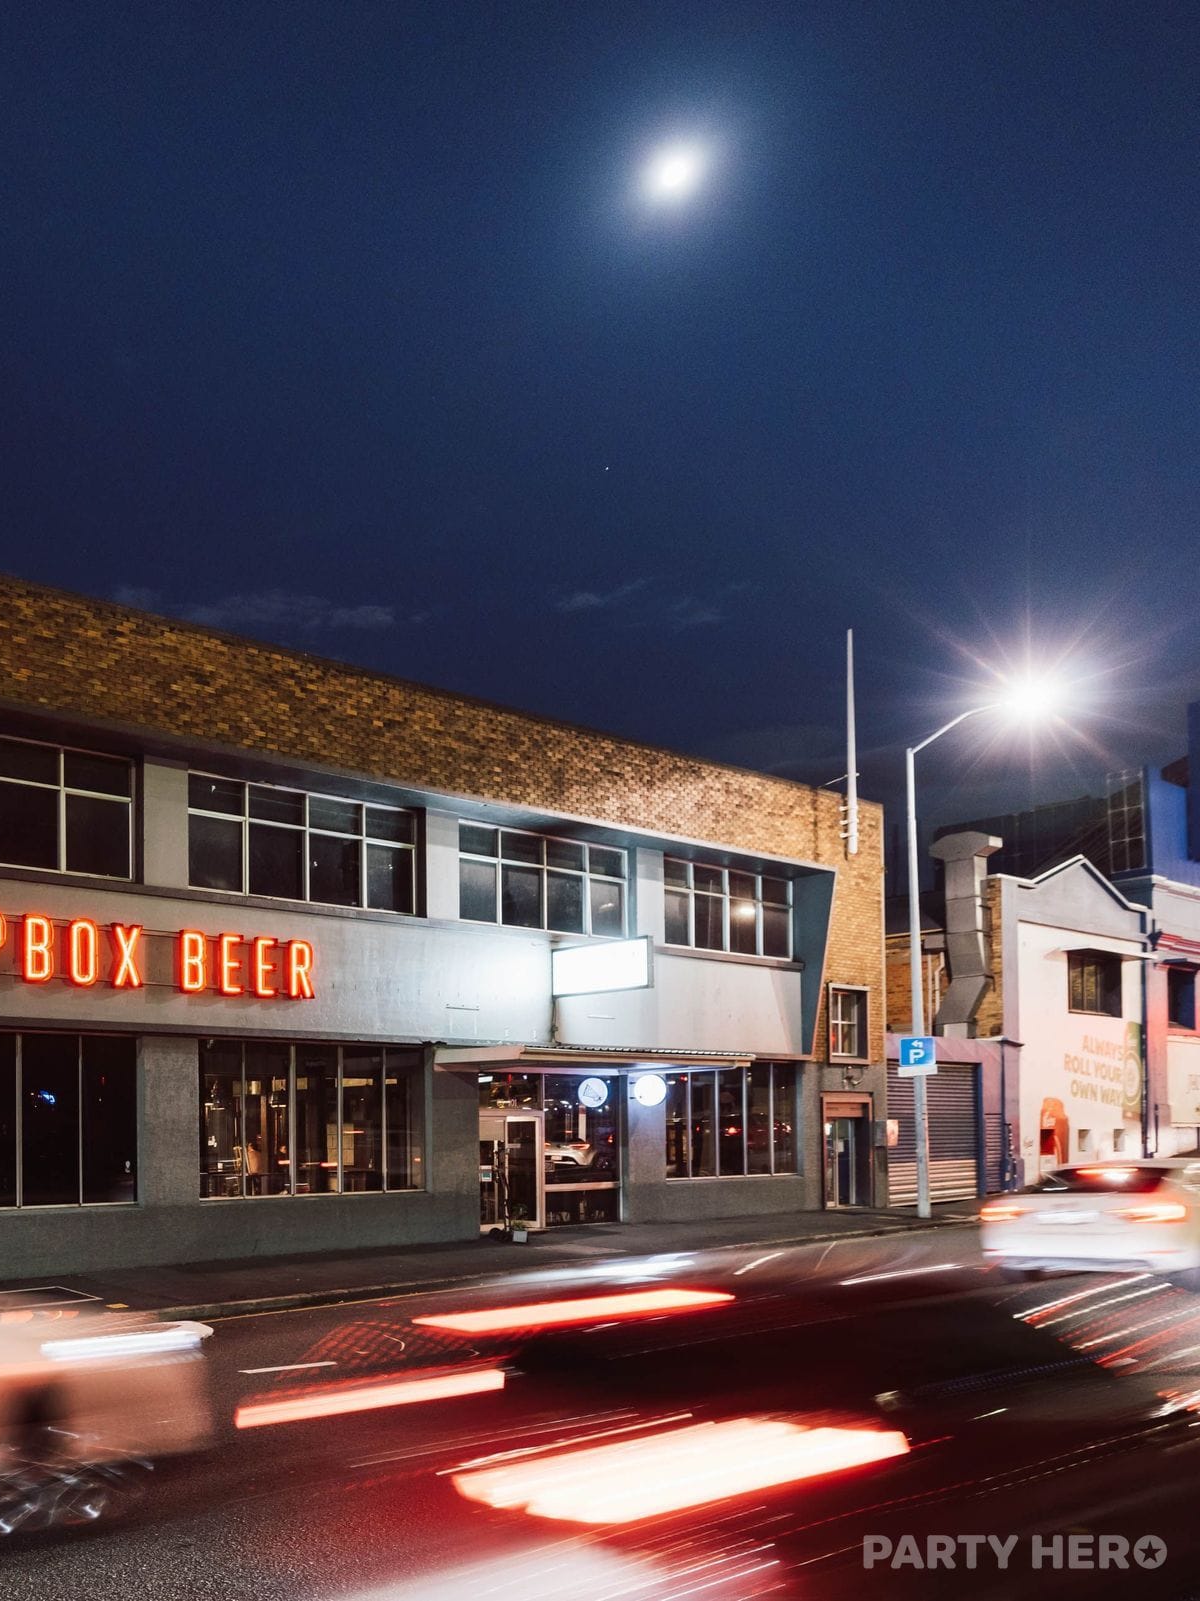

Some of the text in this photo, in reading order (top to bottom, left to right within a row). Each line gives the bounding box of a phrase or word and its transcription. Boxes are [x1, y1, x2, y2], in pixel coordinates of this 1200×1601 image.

[179, 929, 315, 1000] BEER
[909, 1048, 925, 1064] P
[1082, 1034, 1122, 1061] ALWAYS
[1064, 1052, 1090, 1076] ROLL
[1095, 1060, 1122, 1083] YOUR
[1071, 1079, 1098, 1102] OWN
